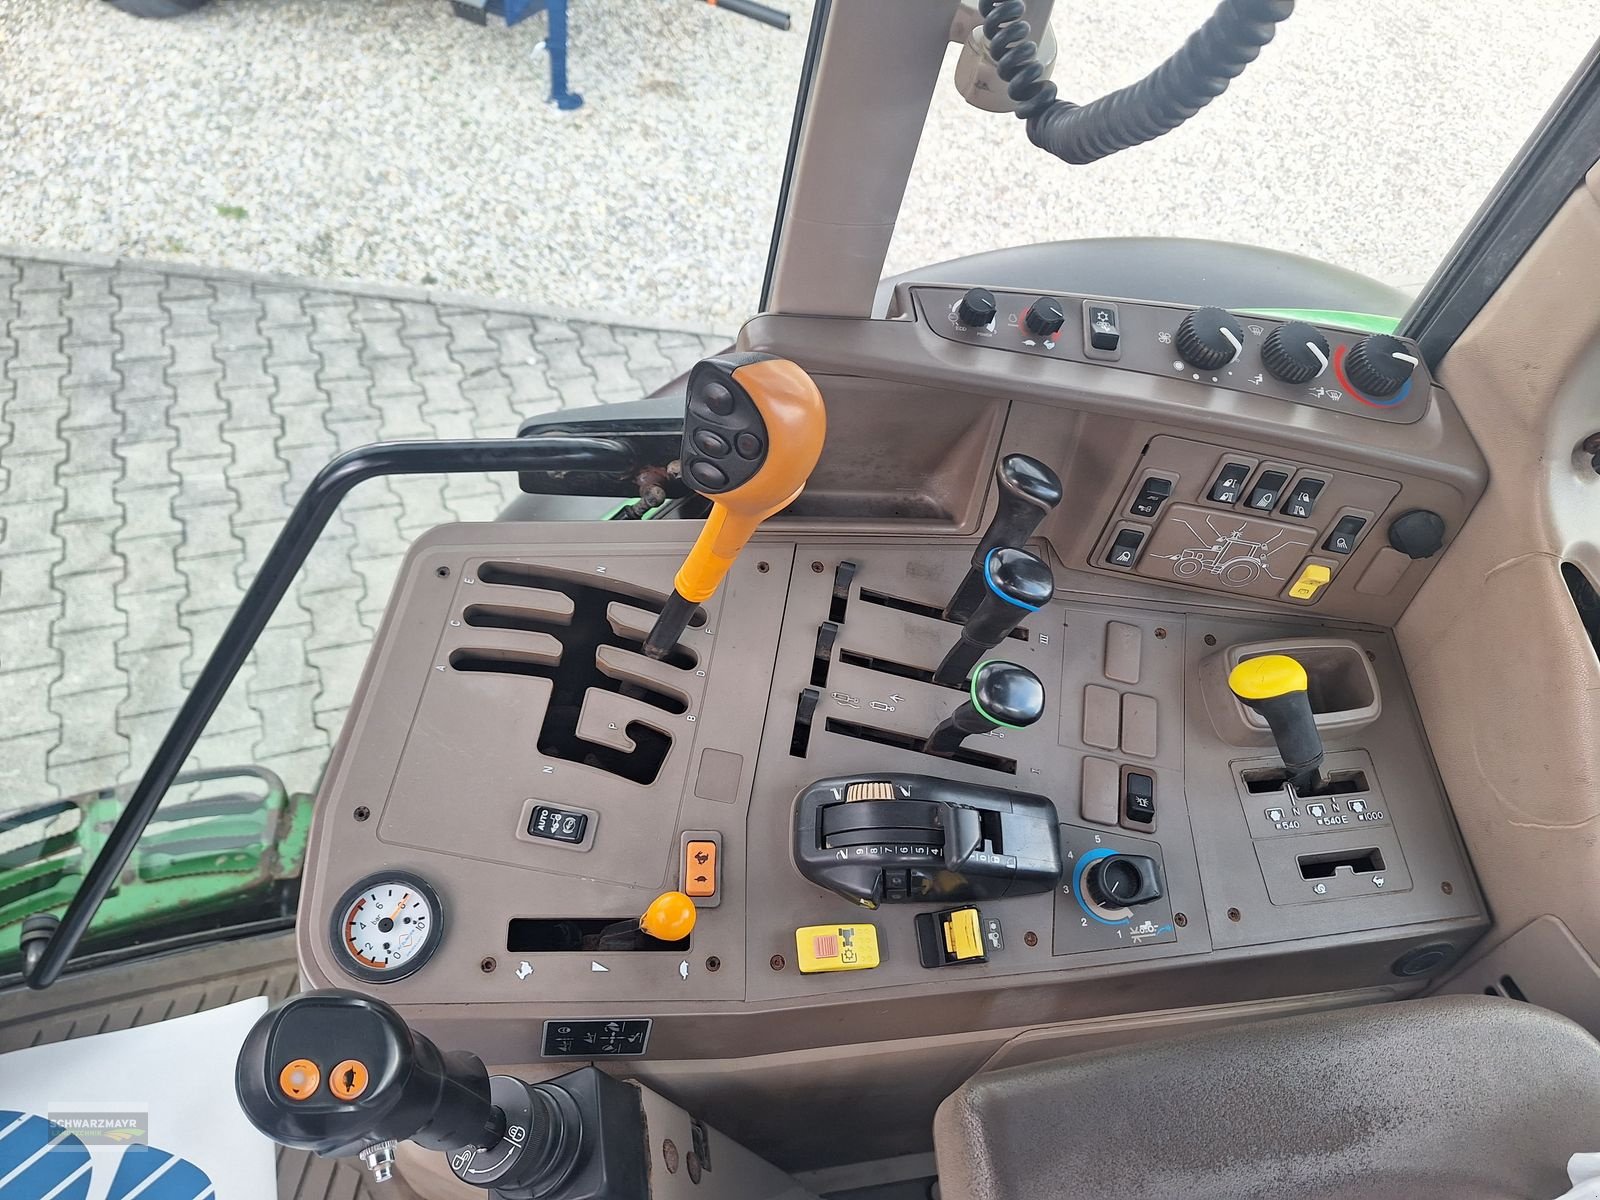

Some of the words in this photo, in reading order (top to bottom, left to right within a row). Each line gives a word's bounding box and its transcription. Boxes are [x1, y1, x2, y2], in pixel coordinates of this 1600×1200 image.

[608, 722, 617, 730] P
[1293, 808, 1300, 816] N
[1332, 804, 1340, 812] N
[538, 809, 549, 831] AUTO
[1364, 811, 1384, 822] 1000
[1281, 820, 1300, 830] 540
[1094, 835, 1101, 843] 5
[915, 846, 925, 854] 5
[1067, 851, 1074, 859] 4
[1062, 885, 1070, 894] 3
[376, 902, 384, 910] 6
[371, 914, 381, 926] bar
[1080, 918, 1088, 927] 2
[359, 922, 367, 930] 4
[1116, 930, 1122, 938] 1
[365, 942, 374, 951] 2
[393, 951, 402, 960] 0
